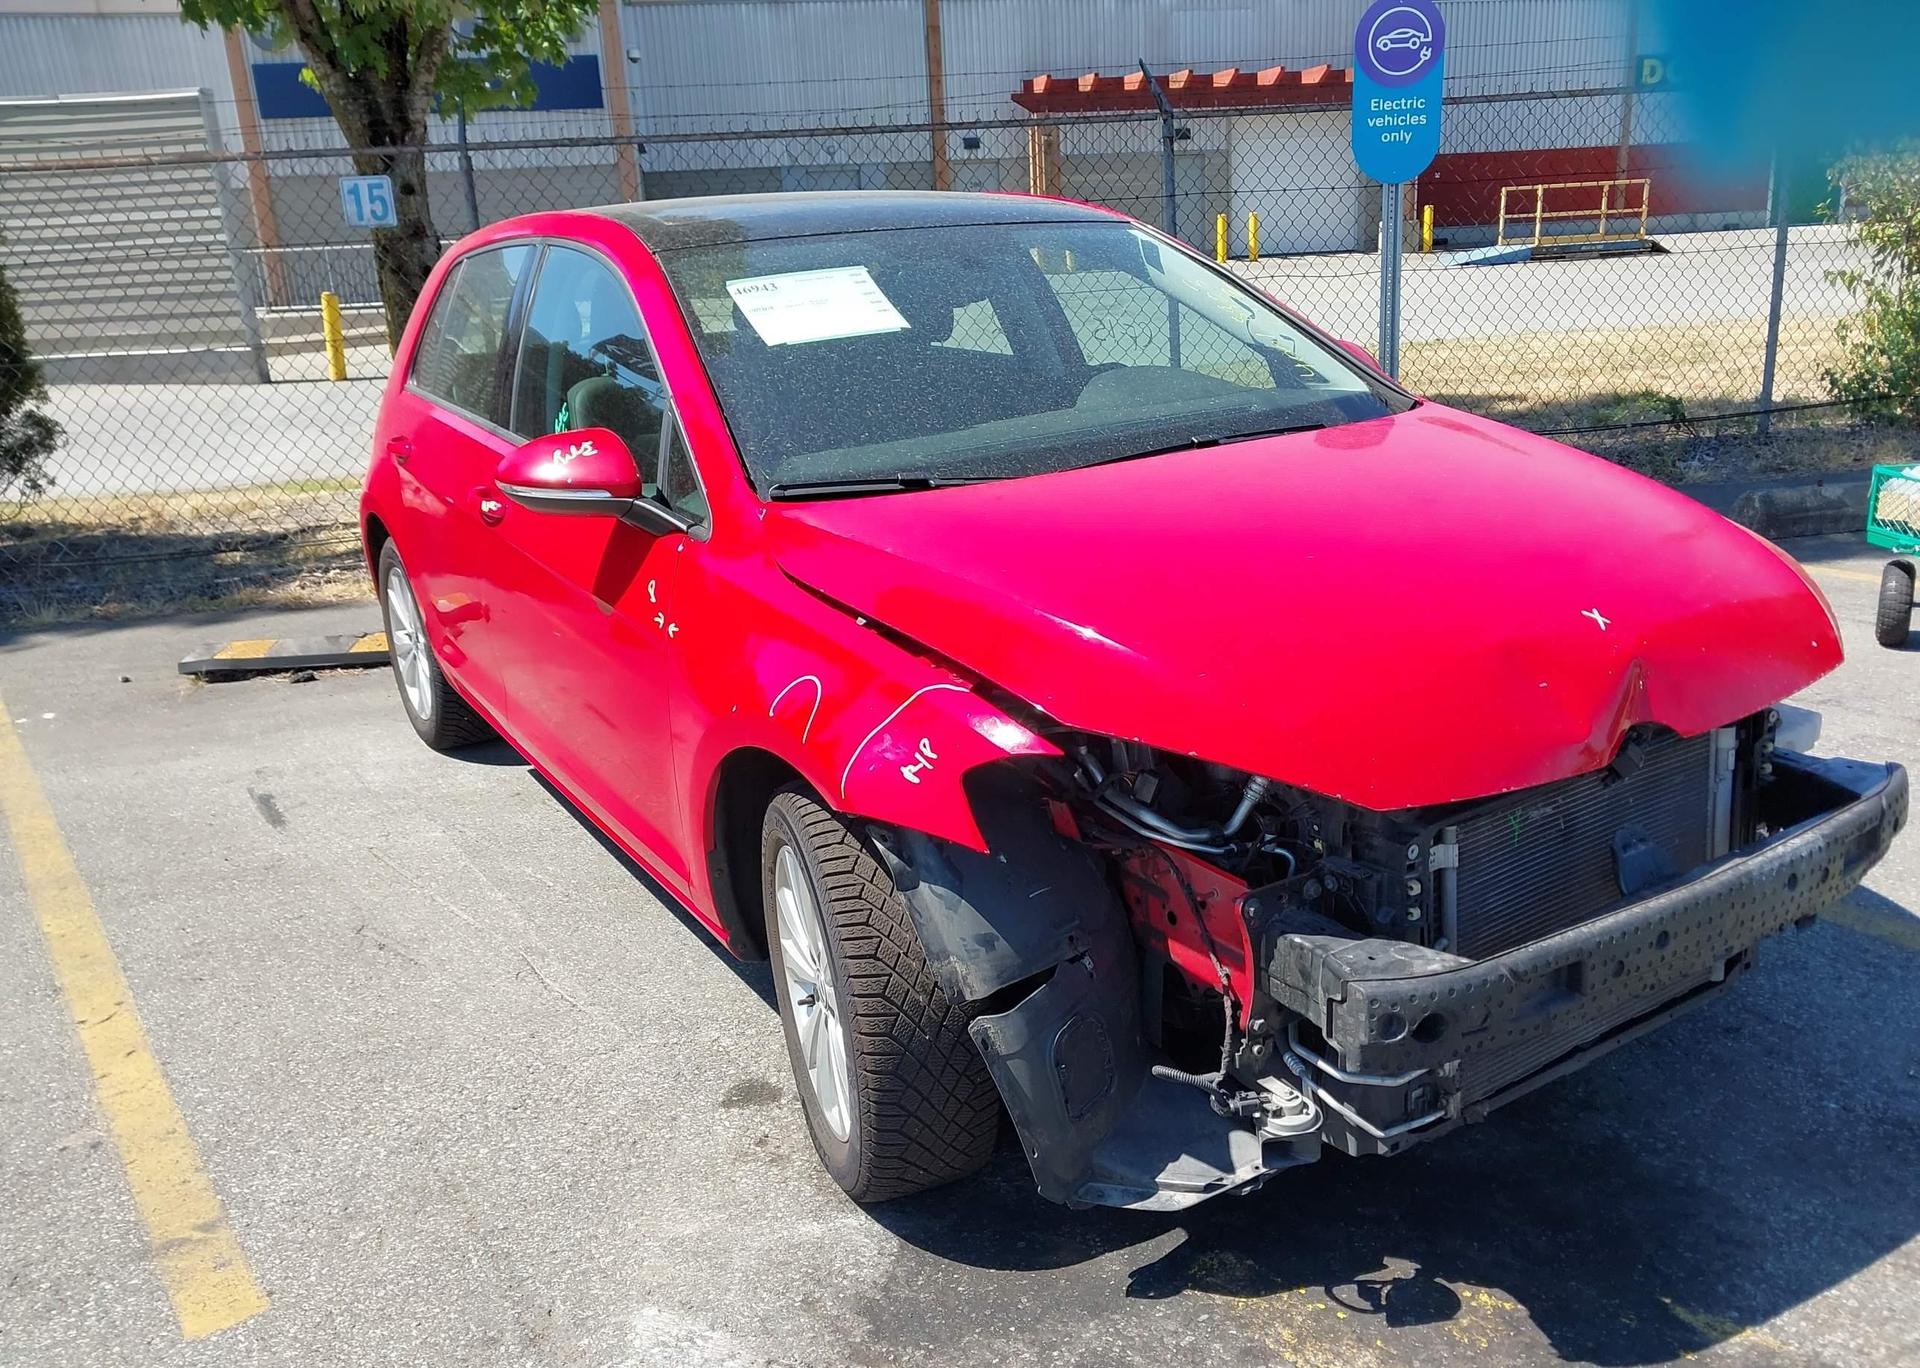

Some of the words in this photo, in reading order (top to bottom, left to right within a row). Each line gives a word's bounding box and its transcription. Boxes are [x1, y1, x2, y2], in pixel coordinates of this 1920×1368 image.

[1370, 96, 1426, 111] Electric
[1367, 113, 1427, 127] vehicles
[1381, 129, 1412, 144] only
[346, 182, 389, 221] 15
